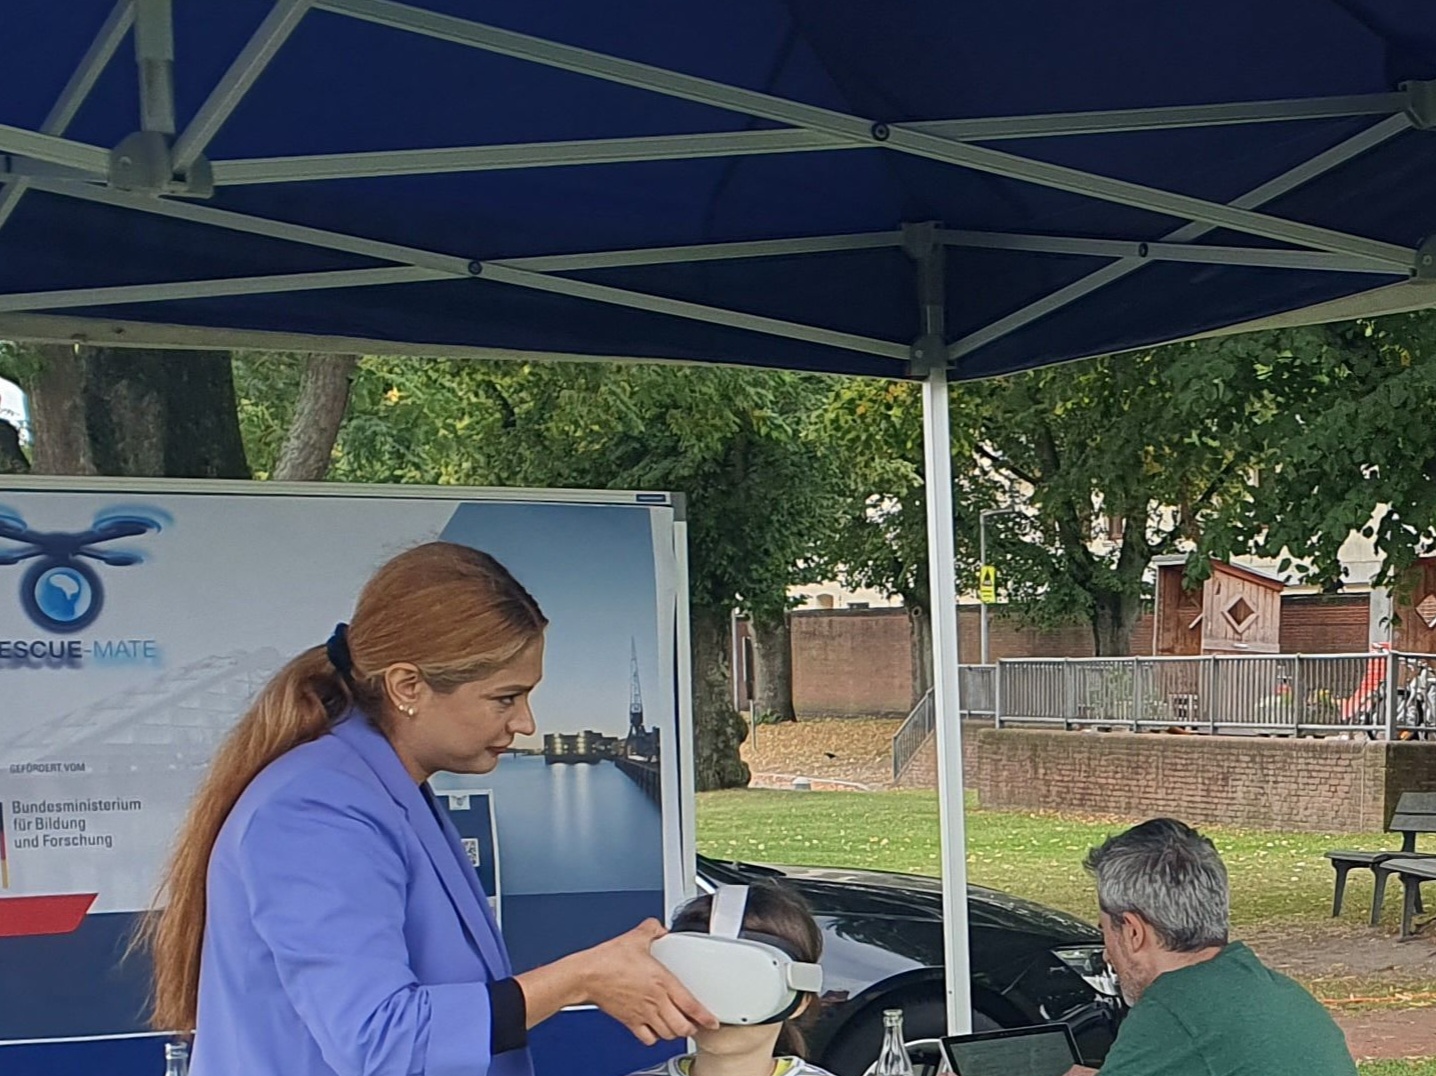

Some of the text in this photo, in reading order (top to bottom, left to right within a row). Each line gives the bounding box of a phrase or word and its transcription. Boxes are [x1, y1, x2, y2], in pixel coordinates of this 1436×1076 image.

[0, 638, 156, 660] ESCUE-MATE
[9, 762, 86, 774] GEFÖRDERT VOM
[12, 797, 142, 816] Bundesministerium
[12, 814, 87, 833] für Bildung
[14, 832, 114, 851] und Forschung
